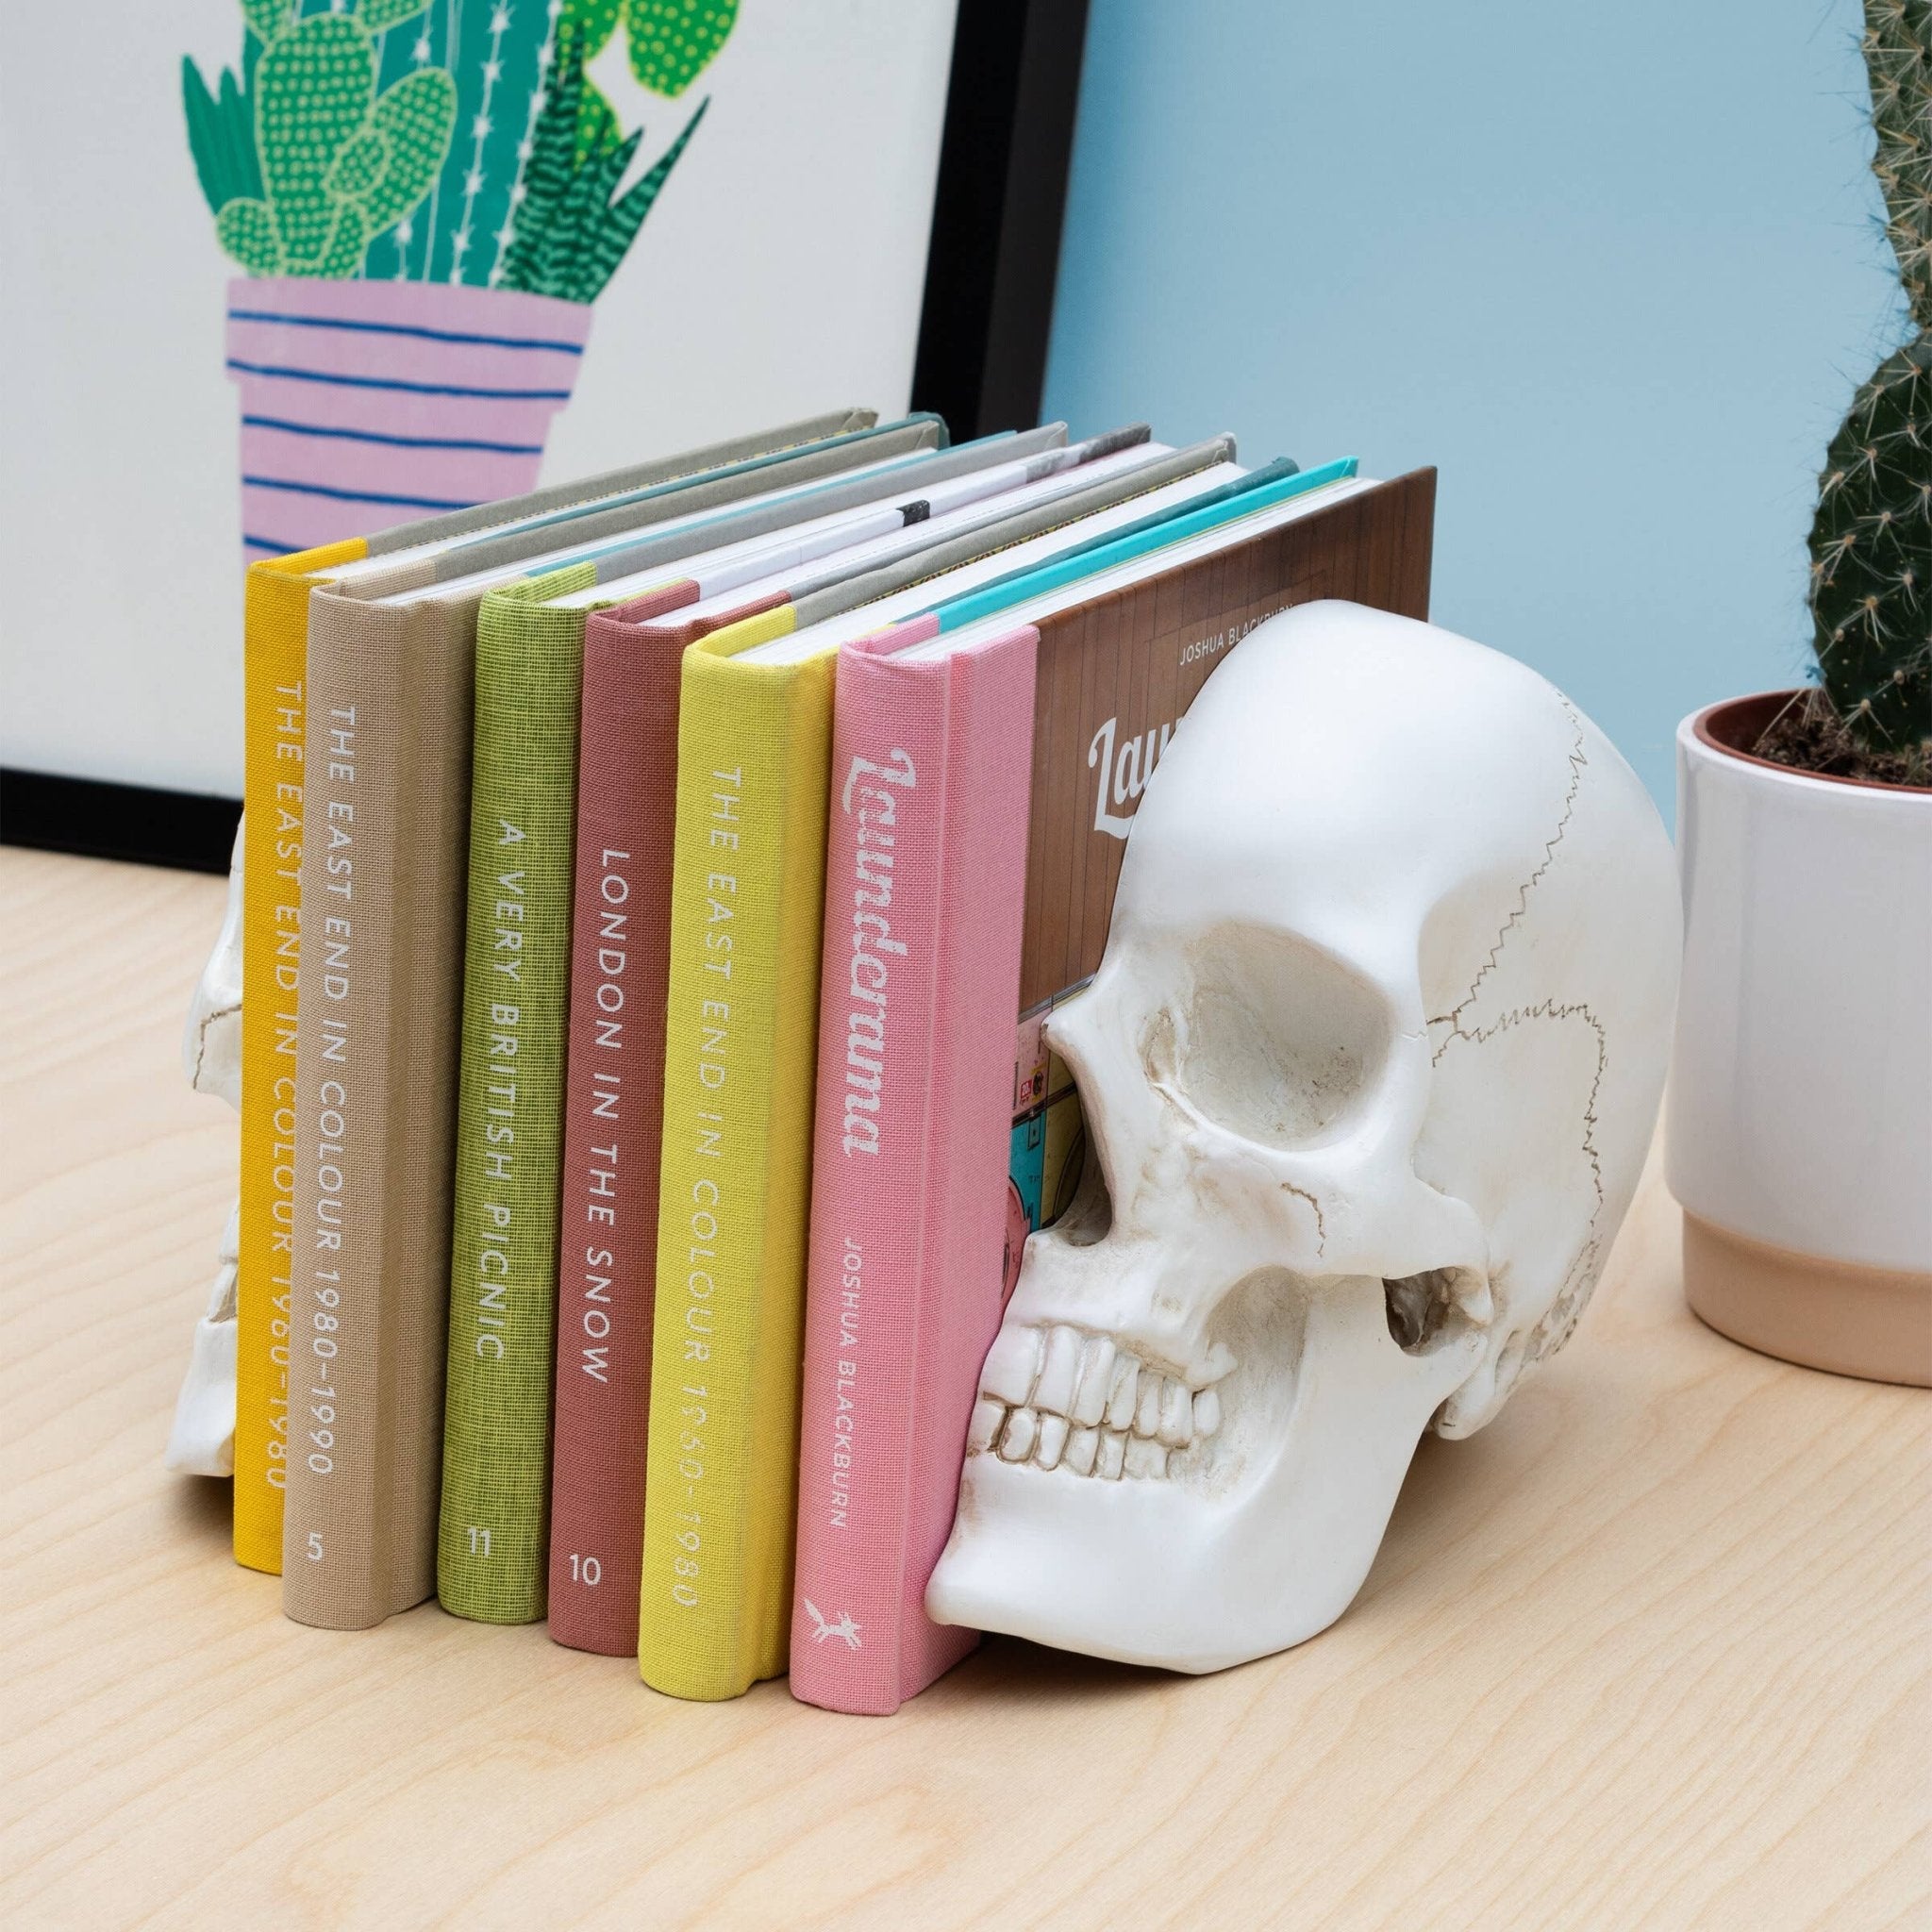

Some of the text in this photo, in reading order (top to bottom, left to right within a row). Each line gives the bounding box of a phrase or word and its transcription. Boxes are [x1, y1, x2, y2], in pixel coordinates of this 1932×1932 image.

[1180, 633, 1224, 666] JOSHUA
[275, 680, 303, 762] THE
[329, 708, 356, 782] THE
[275, 782, 303, 885] EAST
[710, 767, 743, 850] THE
[326, 802, 354, 901] EAST
[275, 905, 302, 991] END
[324, 917, 352, 1000] END
[702, 872, 739, 981] EAST
[275, 1011, 299, 1056] IN
[321, 1019, 347, 1063] IN
[698, 999, 731, 1090] END
[475, 820, 526, 1361] A VERY BRITISH PICNIC
[581, 849, 630, 1384] LONDON IN THE SNOW
[272, 1076, 298, 1253] COLOUR
[316, 1080, 346, 1251] COLOUR
[693, 1111, 724, 1158] IN
[683, 1178, 721, 1363] COLOUR
[830, 1238, 863, 1528] JOSHUA BLACKBURN
[307, 1532, 325, 1561] 5
[466, 1528, 491, 1557] 11
[570, 1555, 601, 1586] 10
